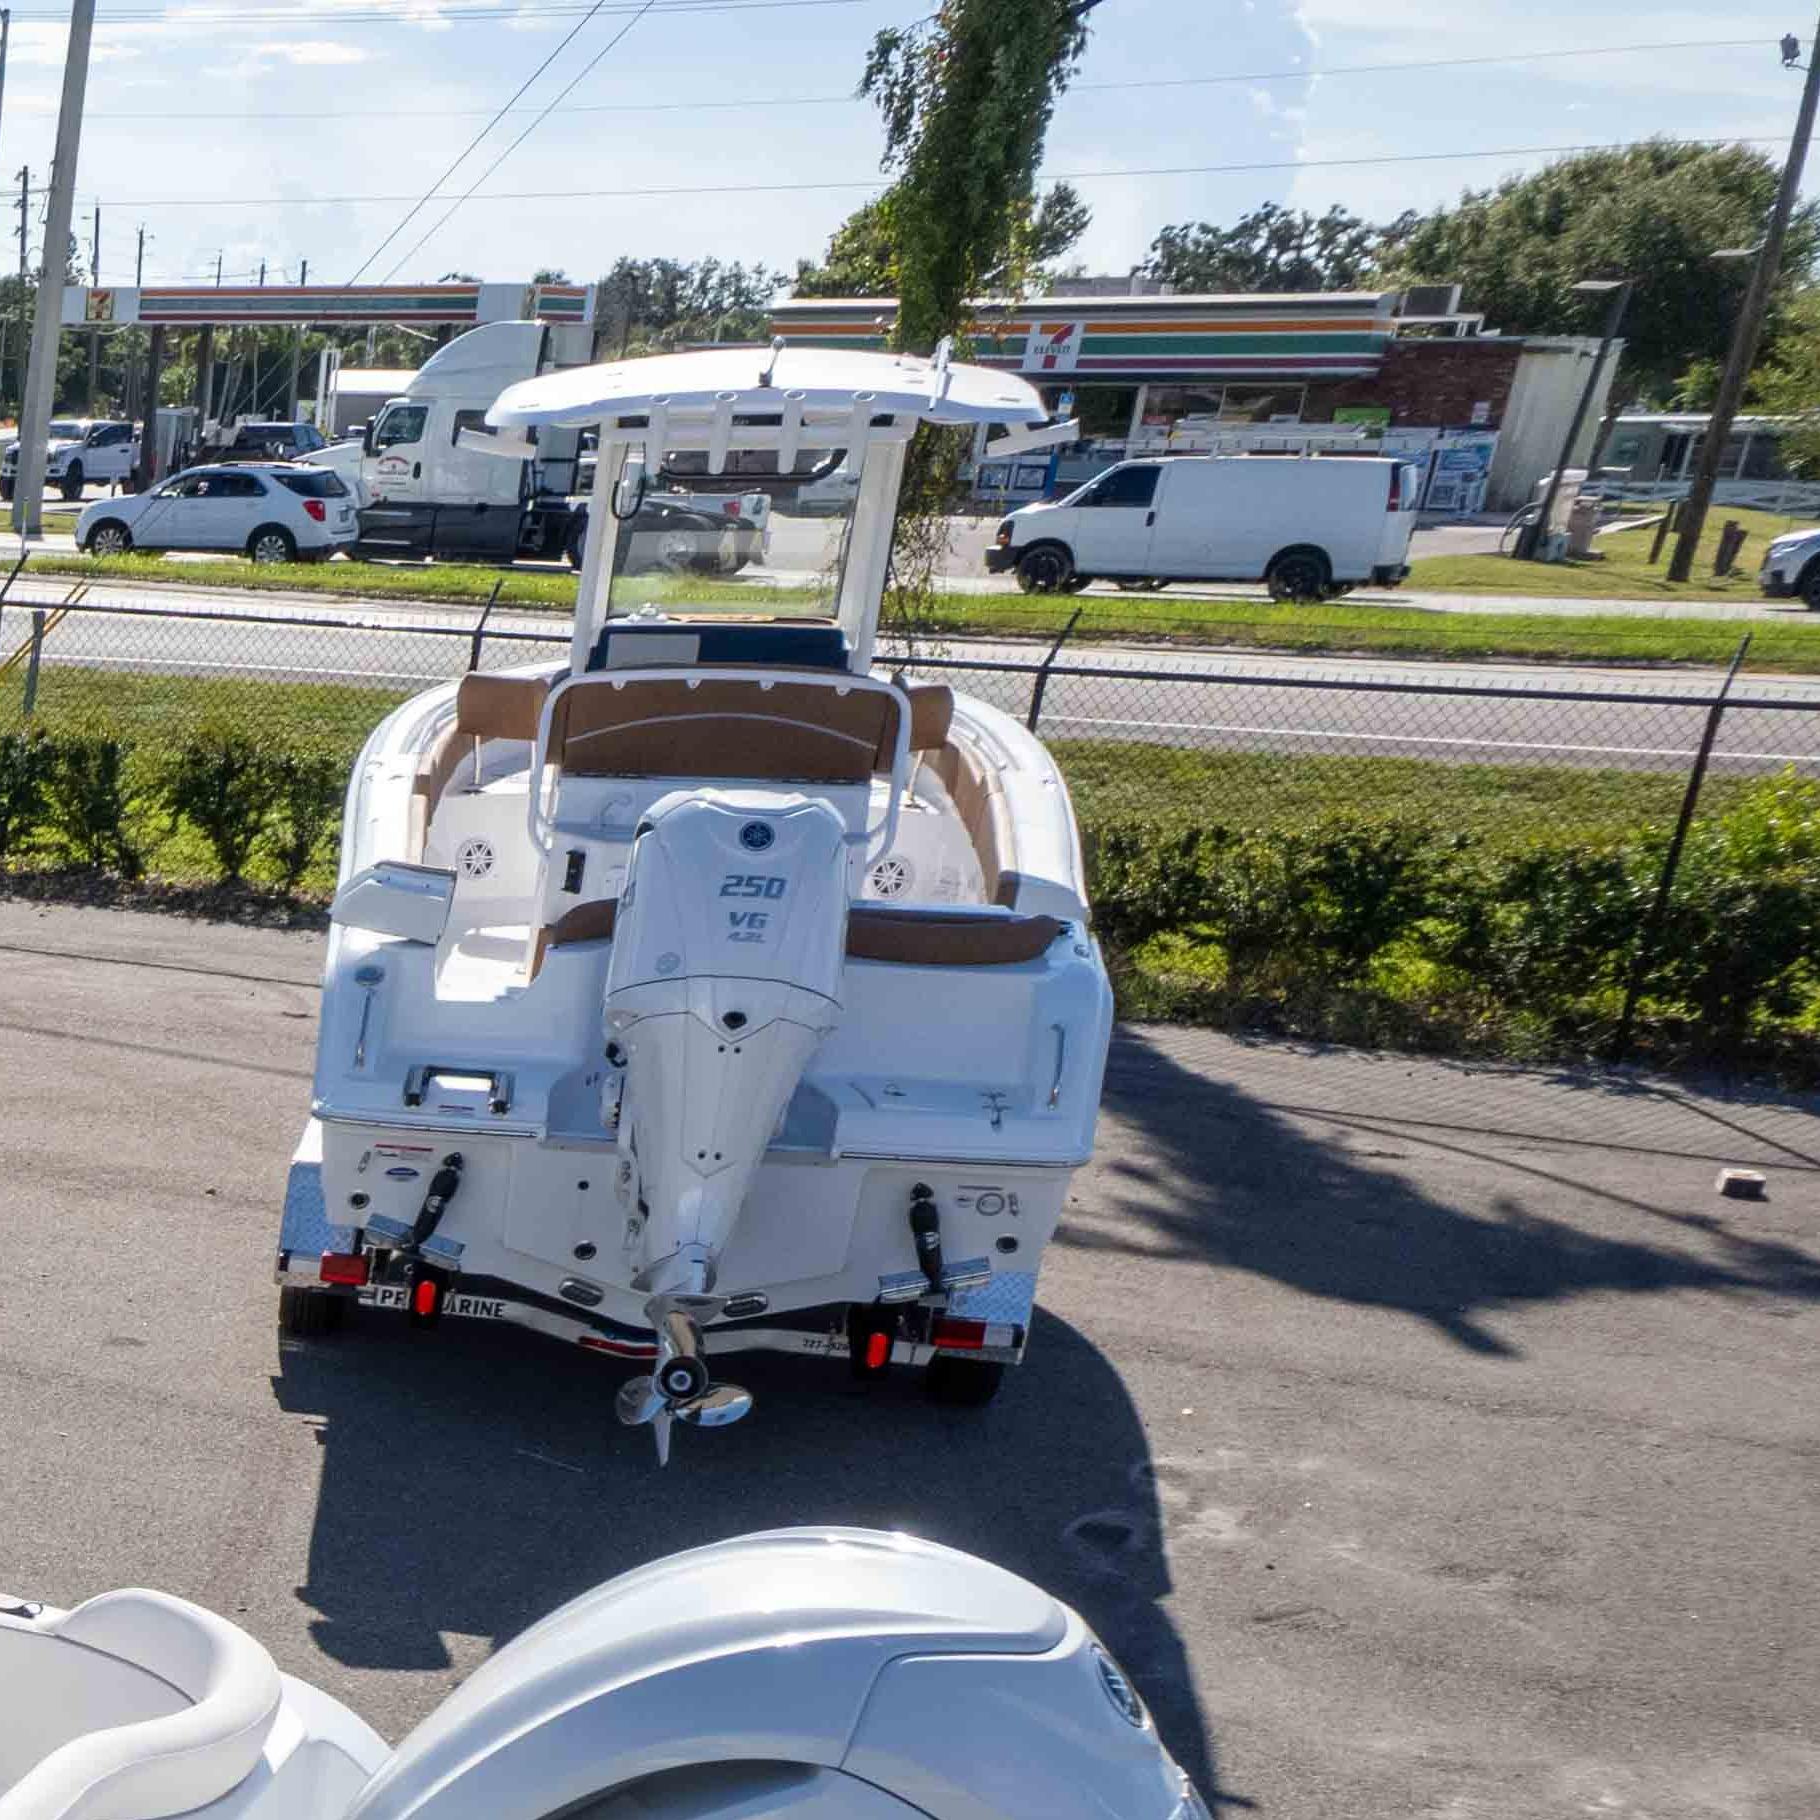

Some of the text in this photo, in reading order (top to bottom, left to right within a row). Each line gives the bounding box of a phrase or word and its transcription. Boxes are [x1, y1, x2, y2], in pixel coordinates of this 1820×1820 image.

[720, 875, 787, 899] 250
[729, 911, 769, 929] V6
[443, 1296, 507, 1318] ARINE
